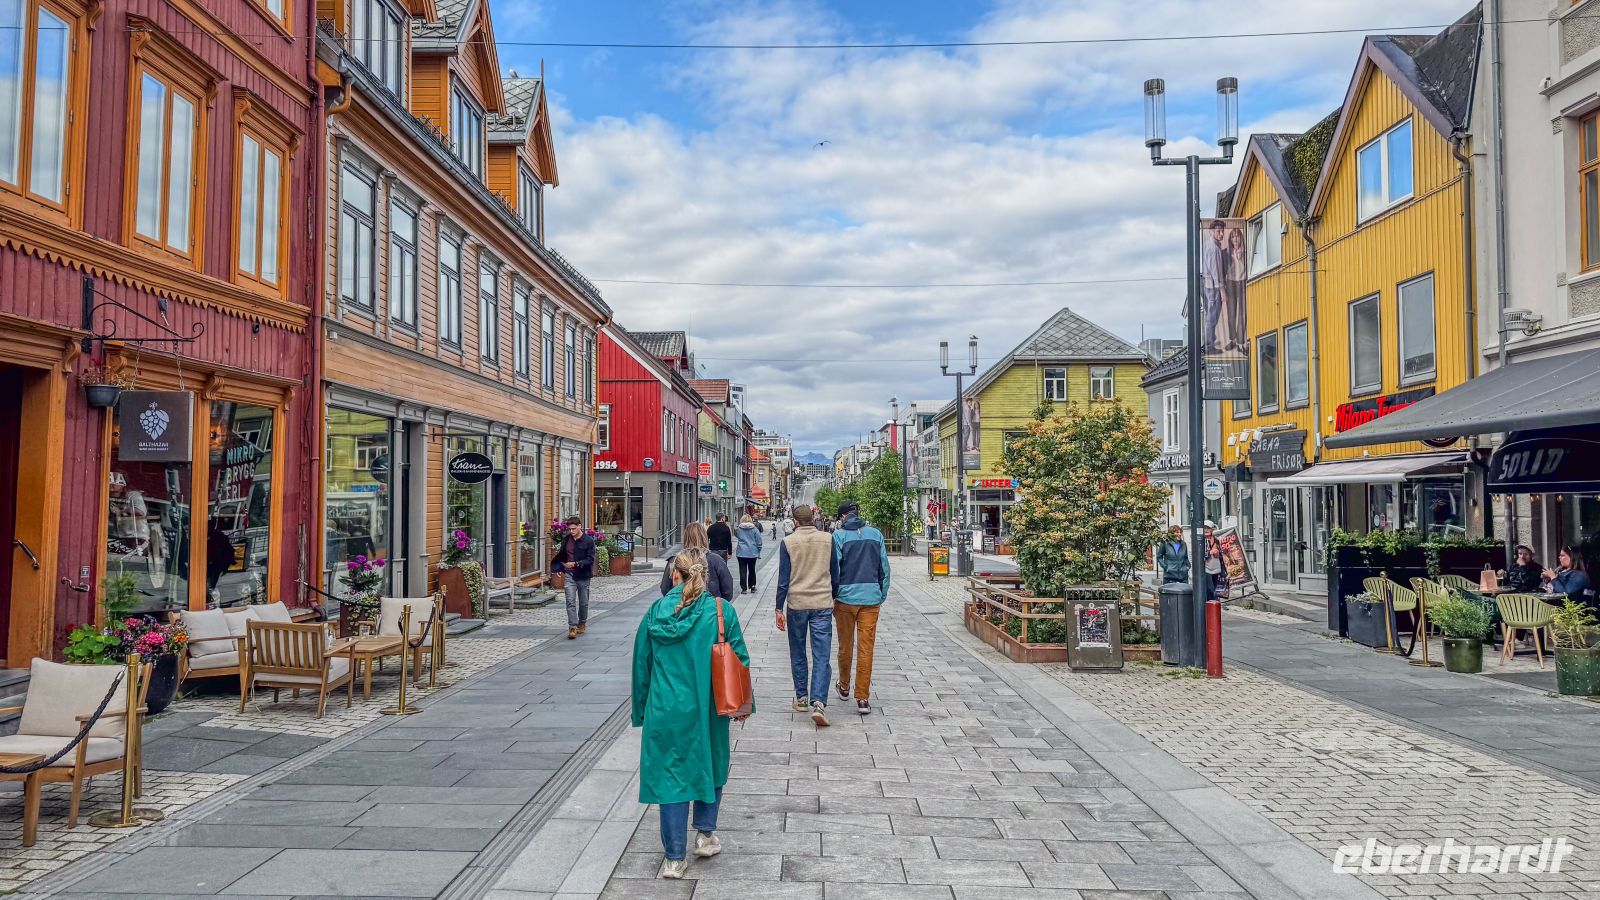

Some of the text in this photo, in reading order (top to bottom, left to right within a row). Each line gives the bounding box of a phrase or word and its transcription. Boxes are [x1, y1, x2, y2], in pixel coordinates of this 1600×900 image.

[1335, 404, 1375, 433] Milano
[226, 444, 255, 465] MIKRO
[594, 460, 618, 470] 1954
[1498, 448, 1564, 480] SOLID
[226, 462, 255, 484] BRYGG
